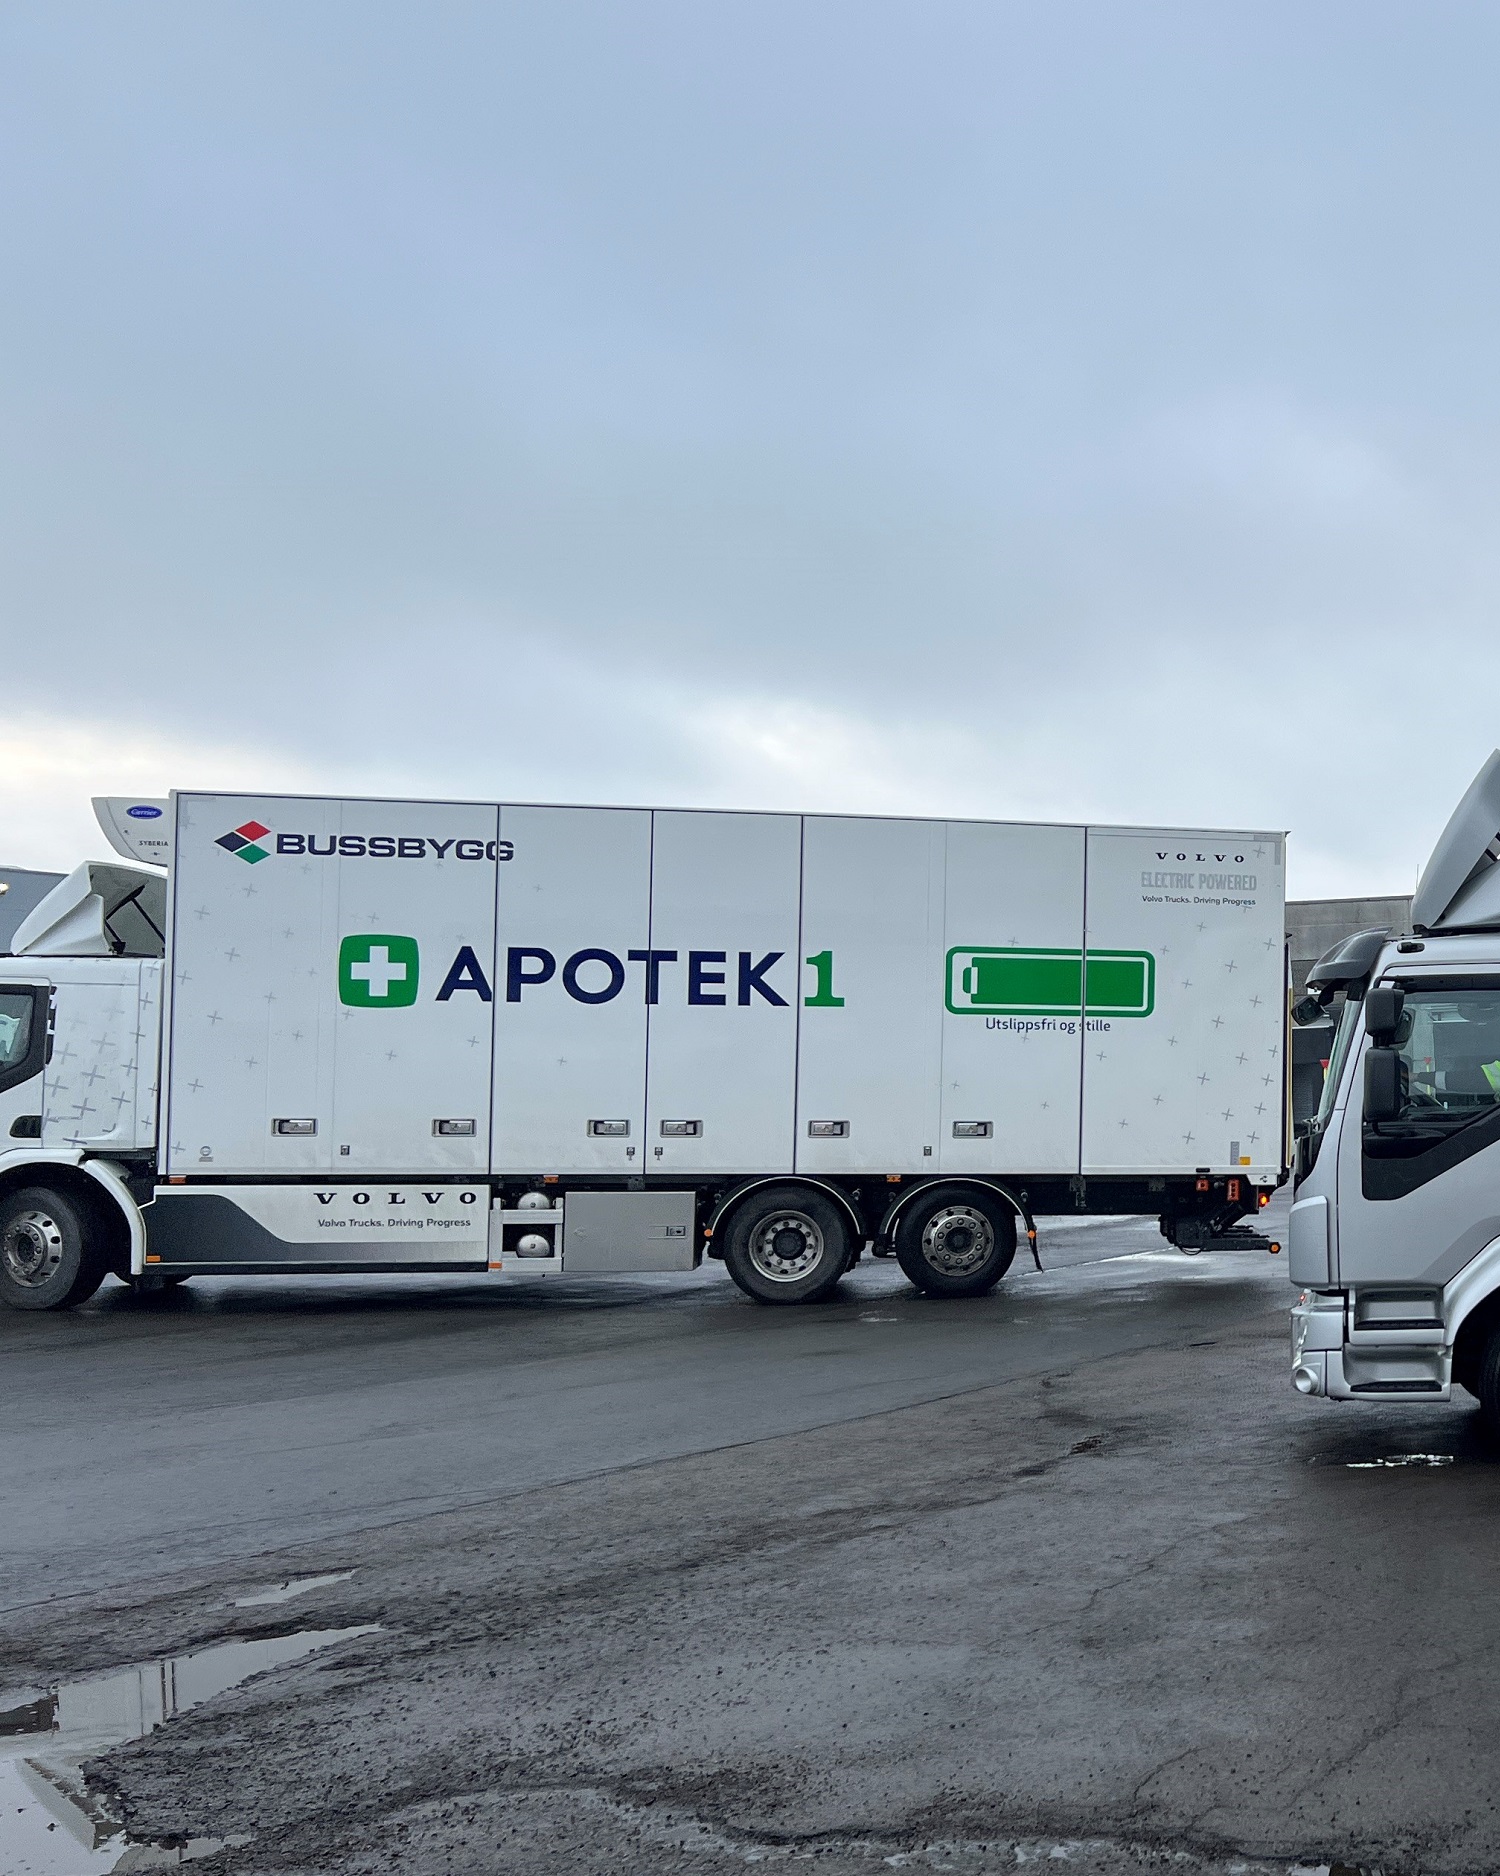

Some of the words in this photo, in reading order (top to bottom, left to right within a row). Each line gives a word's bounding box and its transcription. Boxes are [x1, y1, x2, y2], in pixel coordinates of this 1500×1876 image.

[276, 833, 515, 862] BUSSBYGG
[1155, 852, 1245, 863] VOLVO
[1140, 871, 1195, 889] ELECTRIC
[1199, 872, 1258, 891] POWERED
[1141, 895, 1163, 903] Volvo
[1164, 895, 1192, 904] Trucks.
[1193, 896, 1221, 906] Driving
[1222, 897, 1257, 907] Progress
[434, 945, 791, 1007] APOTEK
[803, 950, 846, 1008] 1
[985, 1017, 1057, 1034] Utslippsfri
[1060, 1021, 1077, 1035] og
[313, 1192, 478, 1205] VOLVO
[317, 1218, 347, 1228] Volvo
[349, 1218, 385, 1228] Trucks.
[387, 1218, 424, 1229] Driving
[426, 1218, 472, 1229] Progress
